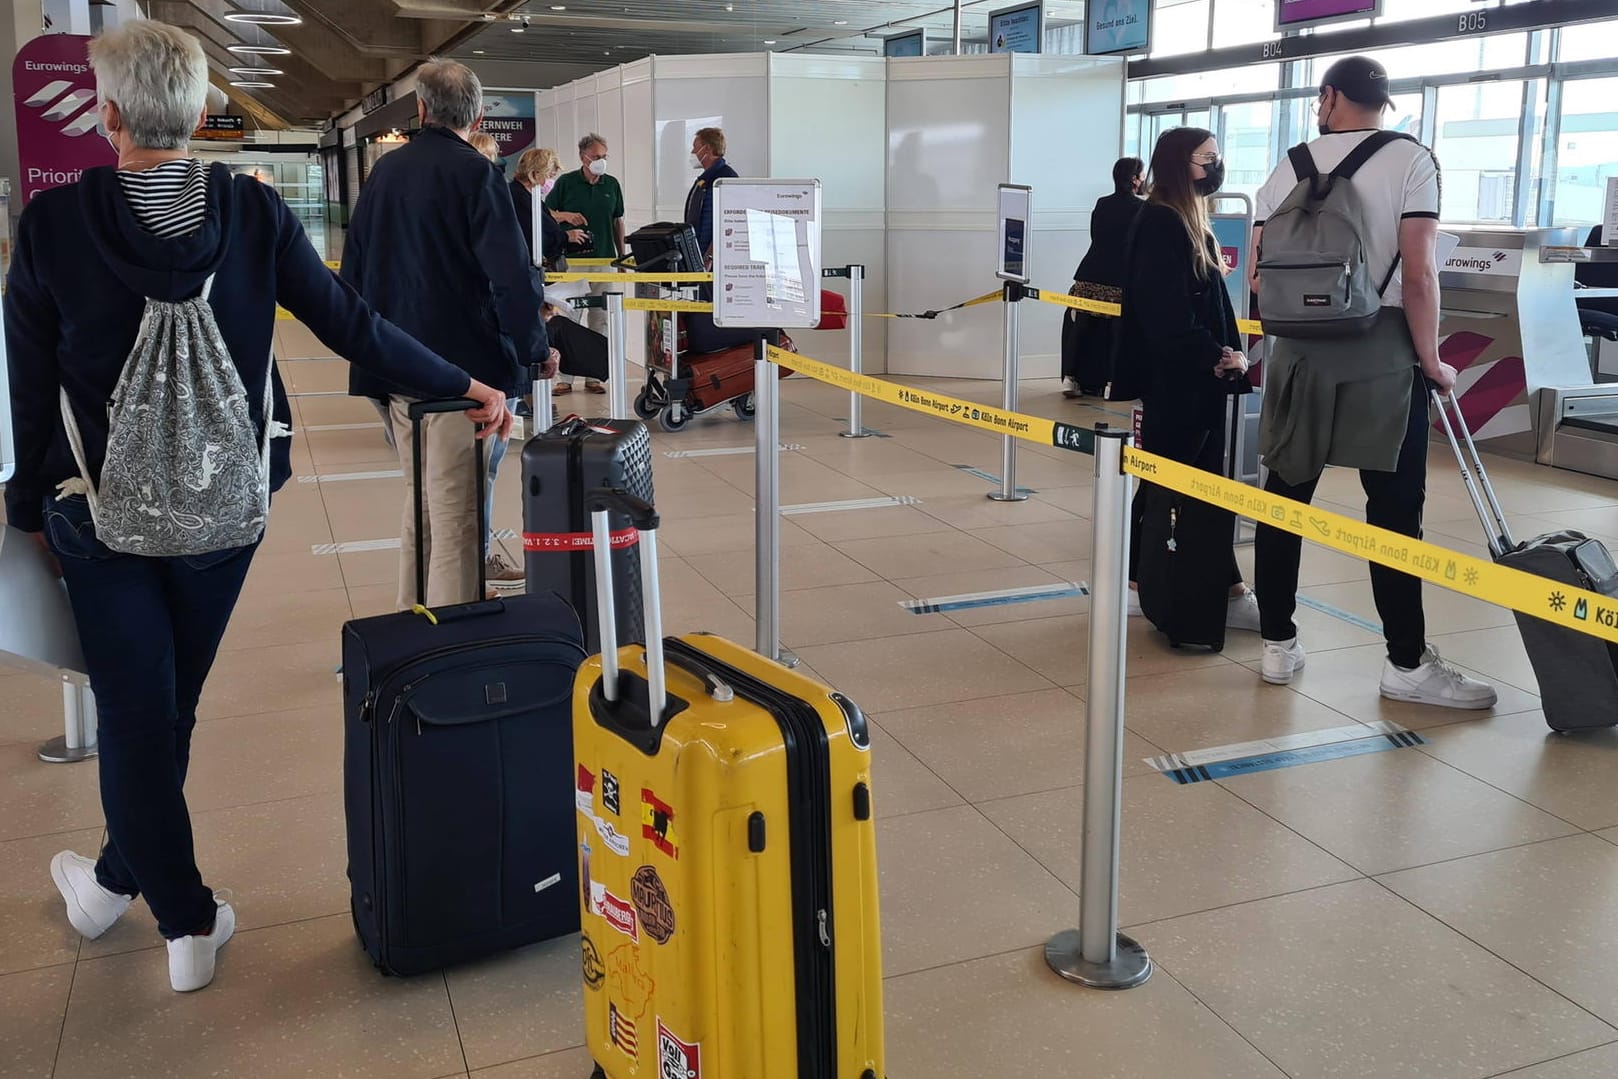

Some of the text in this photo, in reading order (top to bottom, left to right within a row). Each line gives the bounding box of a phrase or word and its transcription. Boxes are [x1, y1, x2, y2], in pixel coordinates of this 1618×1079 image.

[1097, 20, 1114, 30] Gesund
[1458, 11, 1486, 32] B05
[1263, 42, 1282, 57] B04
[25, 60, 88, 74] Eurowings
[28, 167, 83, 184] Priorit
[910, 395, 949, 412] Köln Bonn Airport
[981, 411, 1029, 432] Köln Bonn Airport
[1130, 456, 1158, 474] Airport
[1595, 606, 1618, 628] Köl
